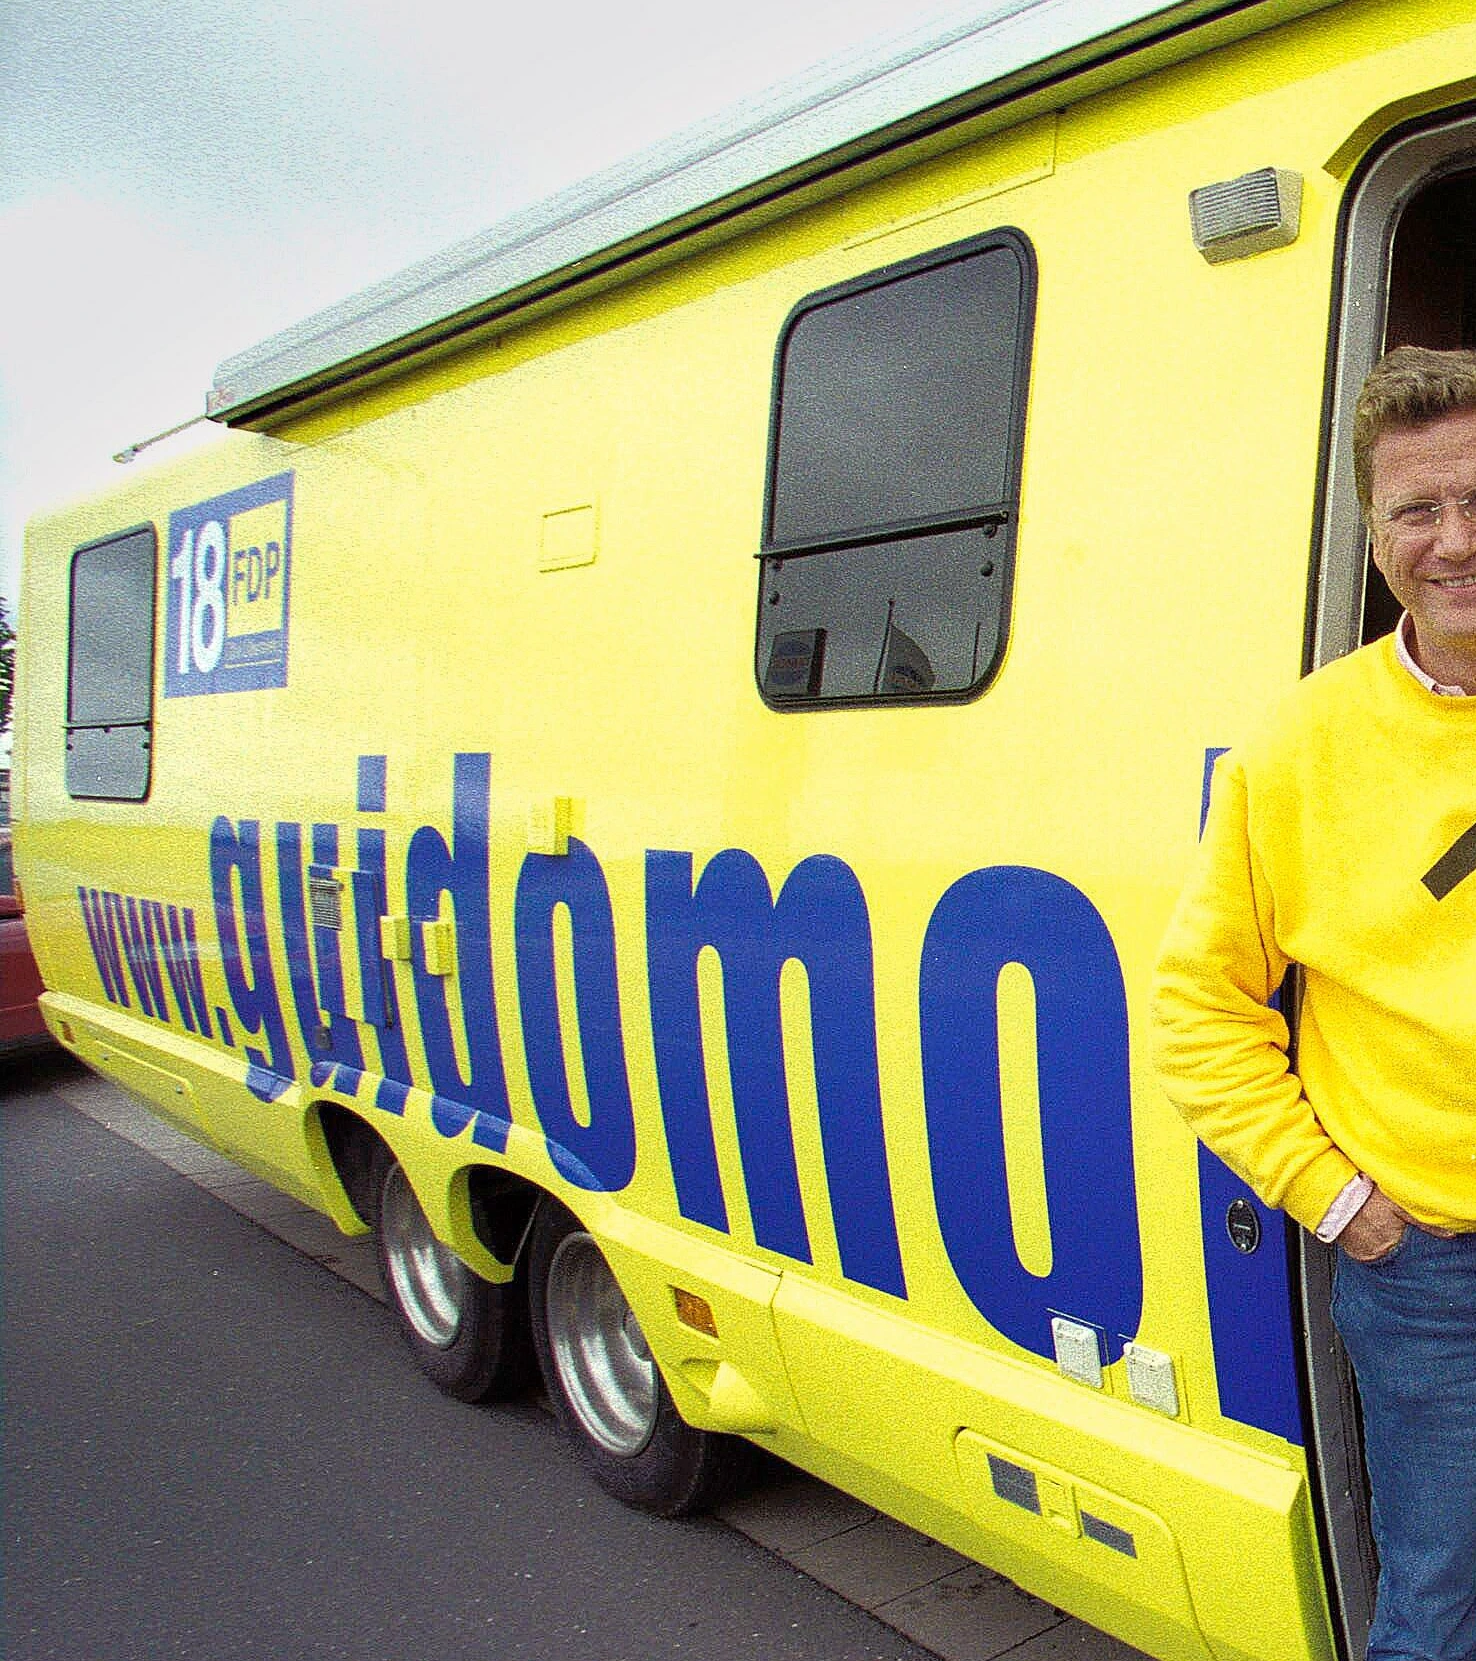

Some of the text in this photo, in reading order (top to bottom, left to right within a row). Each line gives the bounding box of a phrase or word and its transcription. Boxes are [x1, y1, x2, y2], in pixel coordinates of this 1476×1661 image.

[171, 520, 280, 675] 18 FDP
[77, 747, 1304, 1447] www.guidomo
